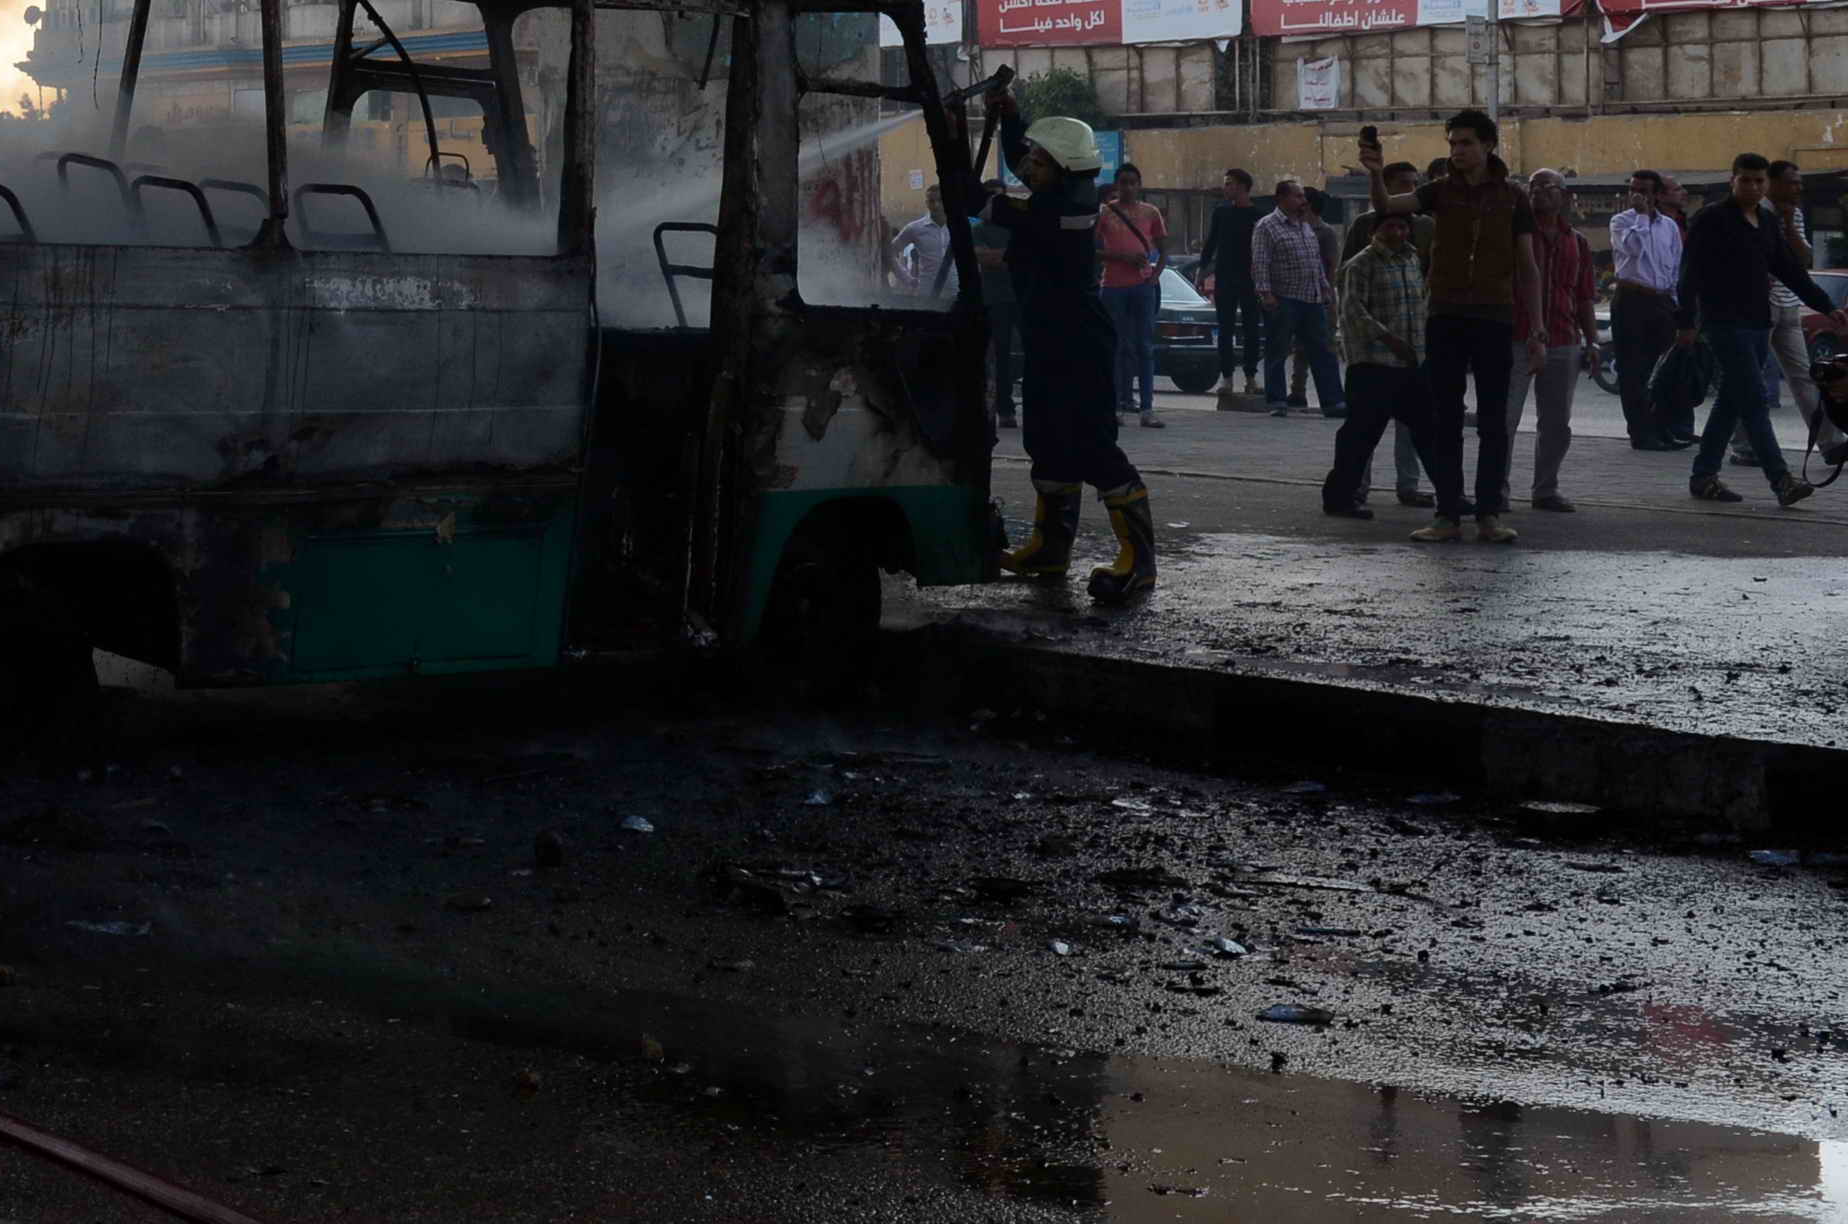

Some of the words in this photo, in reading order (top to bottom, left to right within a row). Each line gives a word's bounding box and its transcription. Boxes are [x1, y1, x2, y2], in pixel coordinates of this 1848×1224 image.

[1055, 12, 1083, 32] واحد
[1084, 9, 1105, 28] لكل
[1361, 12, 1405, 30] علشان
